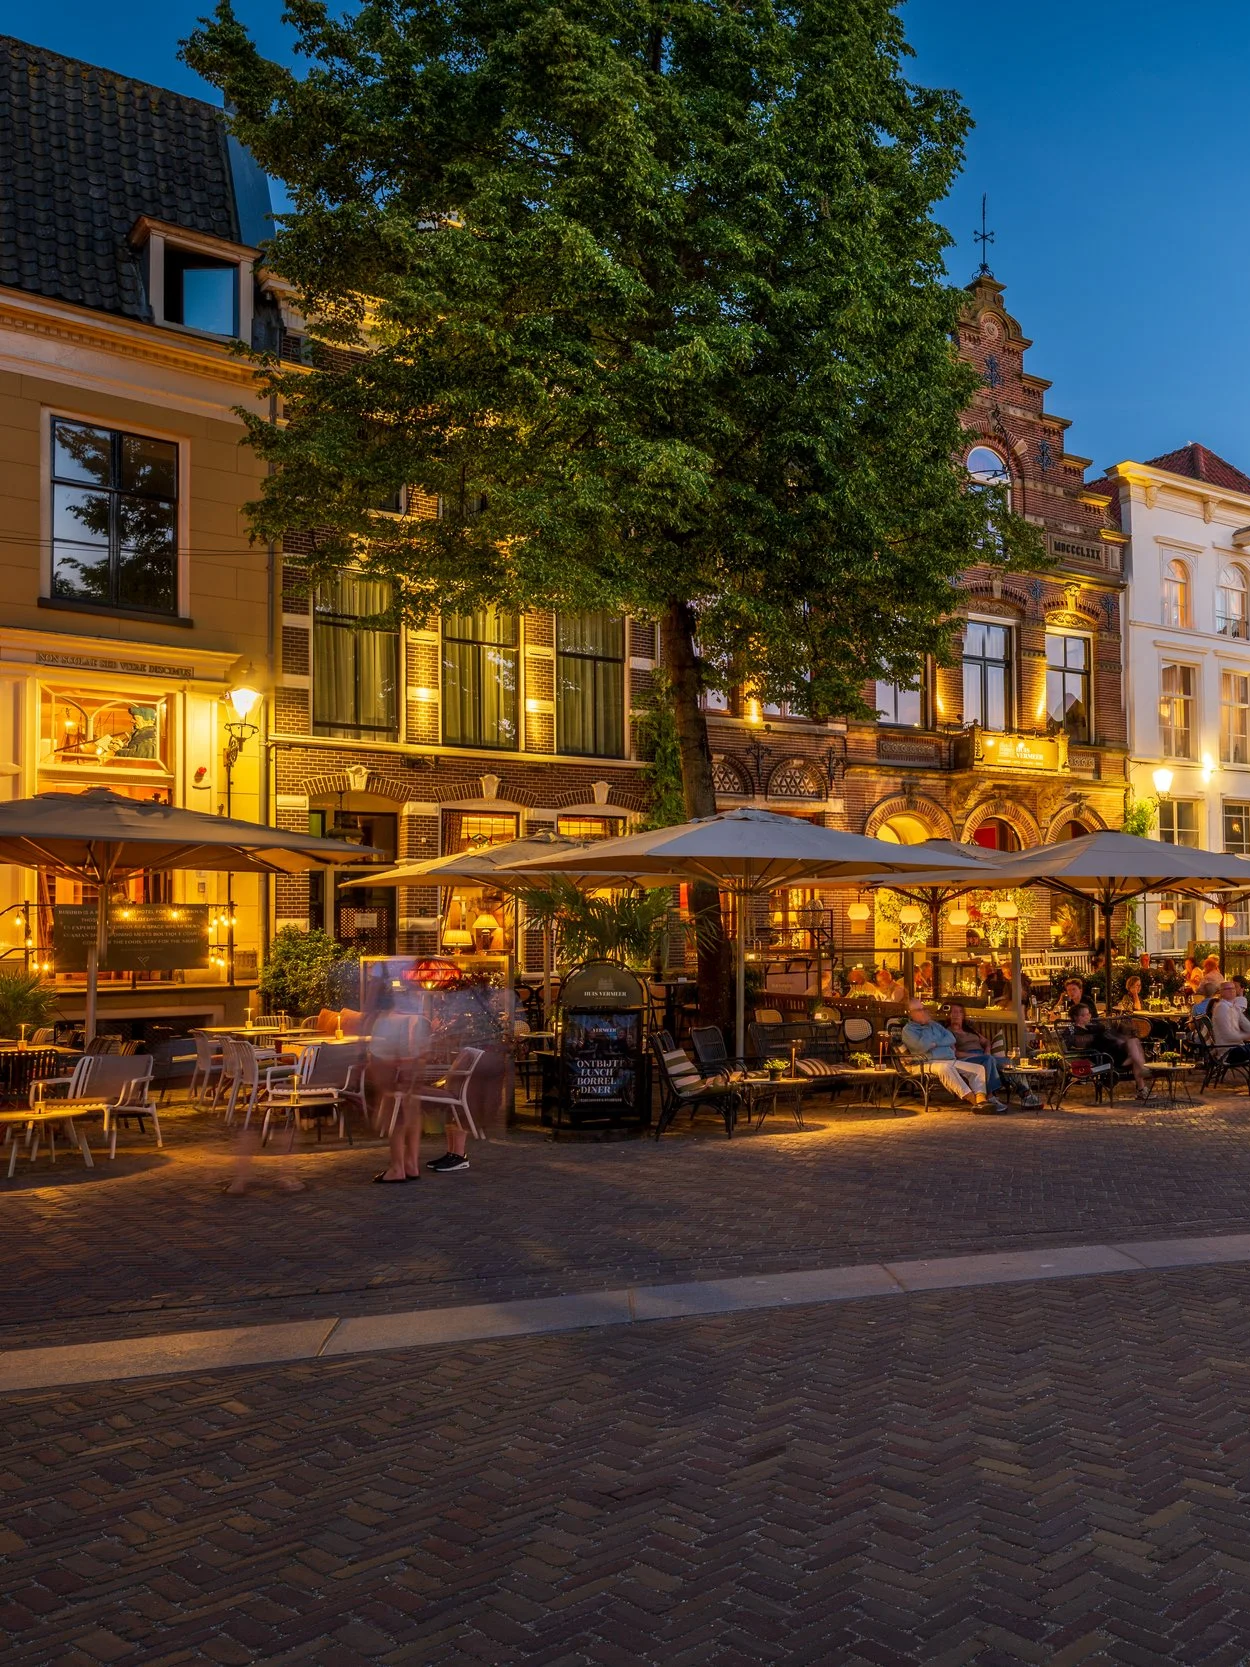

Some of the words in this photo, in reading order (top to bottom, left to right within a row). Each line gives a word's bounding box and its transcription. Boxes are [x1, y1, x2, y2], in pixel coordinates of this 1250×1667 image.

[38, 653, 59, 663] NON
[576, 1059, 618, 1068] ONTBIJT
[580, 1068, 614, 1077] LUNCH
[576, 1077, 617, 1085] BORREL
[580, 1086, 611, 1094] DINER
